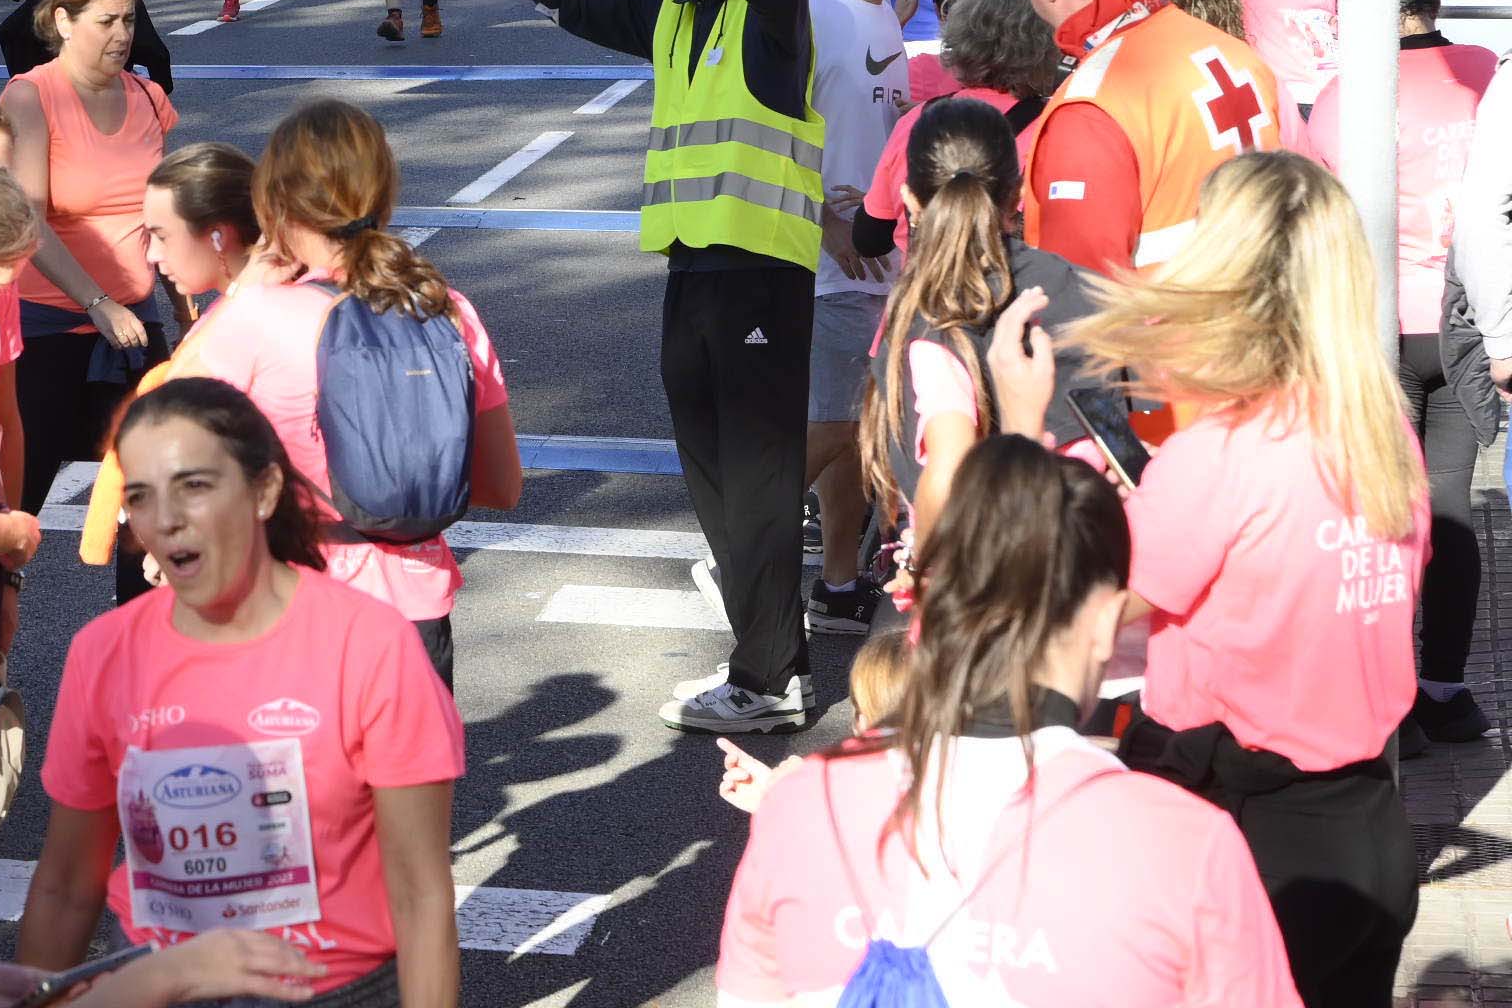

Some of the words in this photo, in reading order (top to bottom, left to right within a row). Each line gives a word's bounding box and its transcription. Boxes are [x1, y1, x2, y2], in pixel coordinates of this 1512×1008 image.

[1341, 546, 1372, 580] DE
[1376, 543, 1403, 573] LA
[1335, 573, 1407, 615] MUJER
[161, 782, 235, 800] ASTURIANA
[168, 821, 238, 852] 016
[184, 856, 227, 876] 6070
[238, 897, 302, 916] Santander
